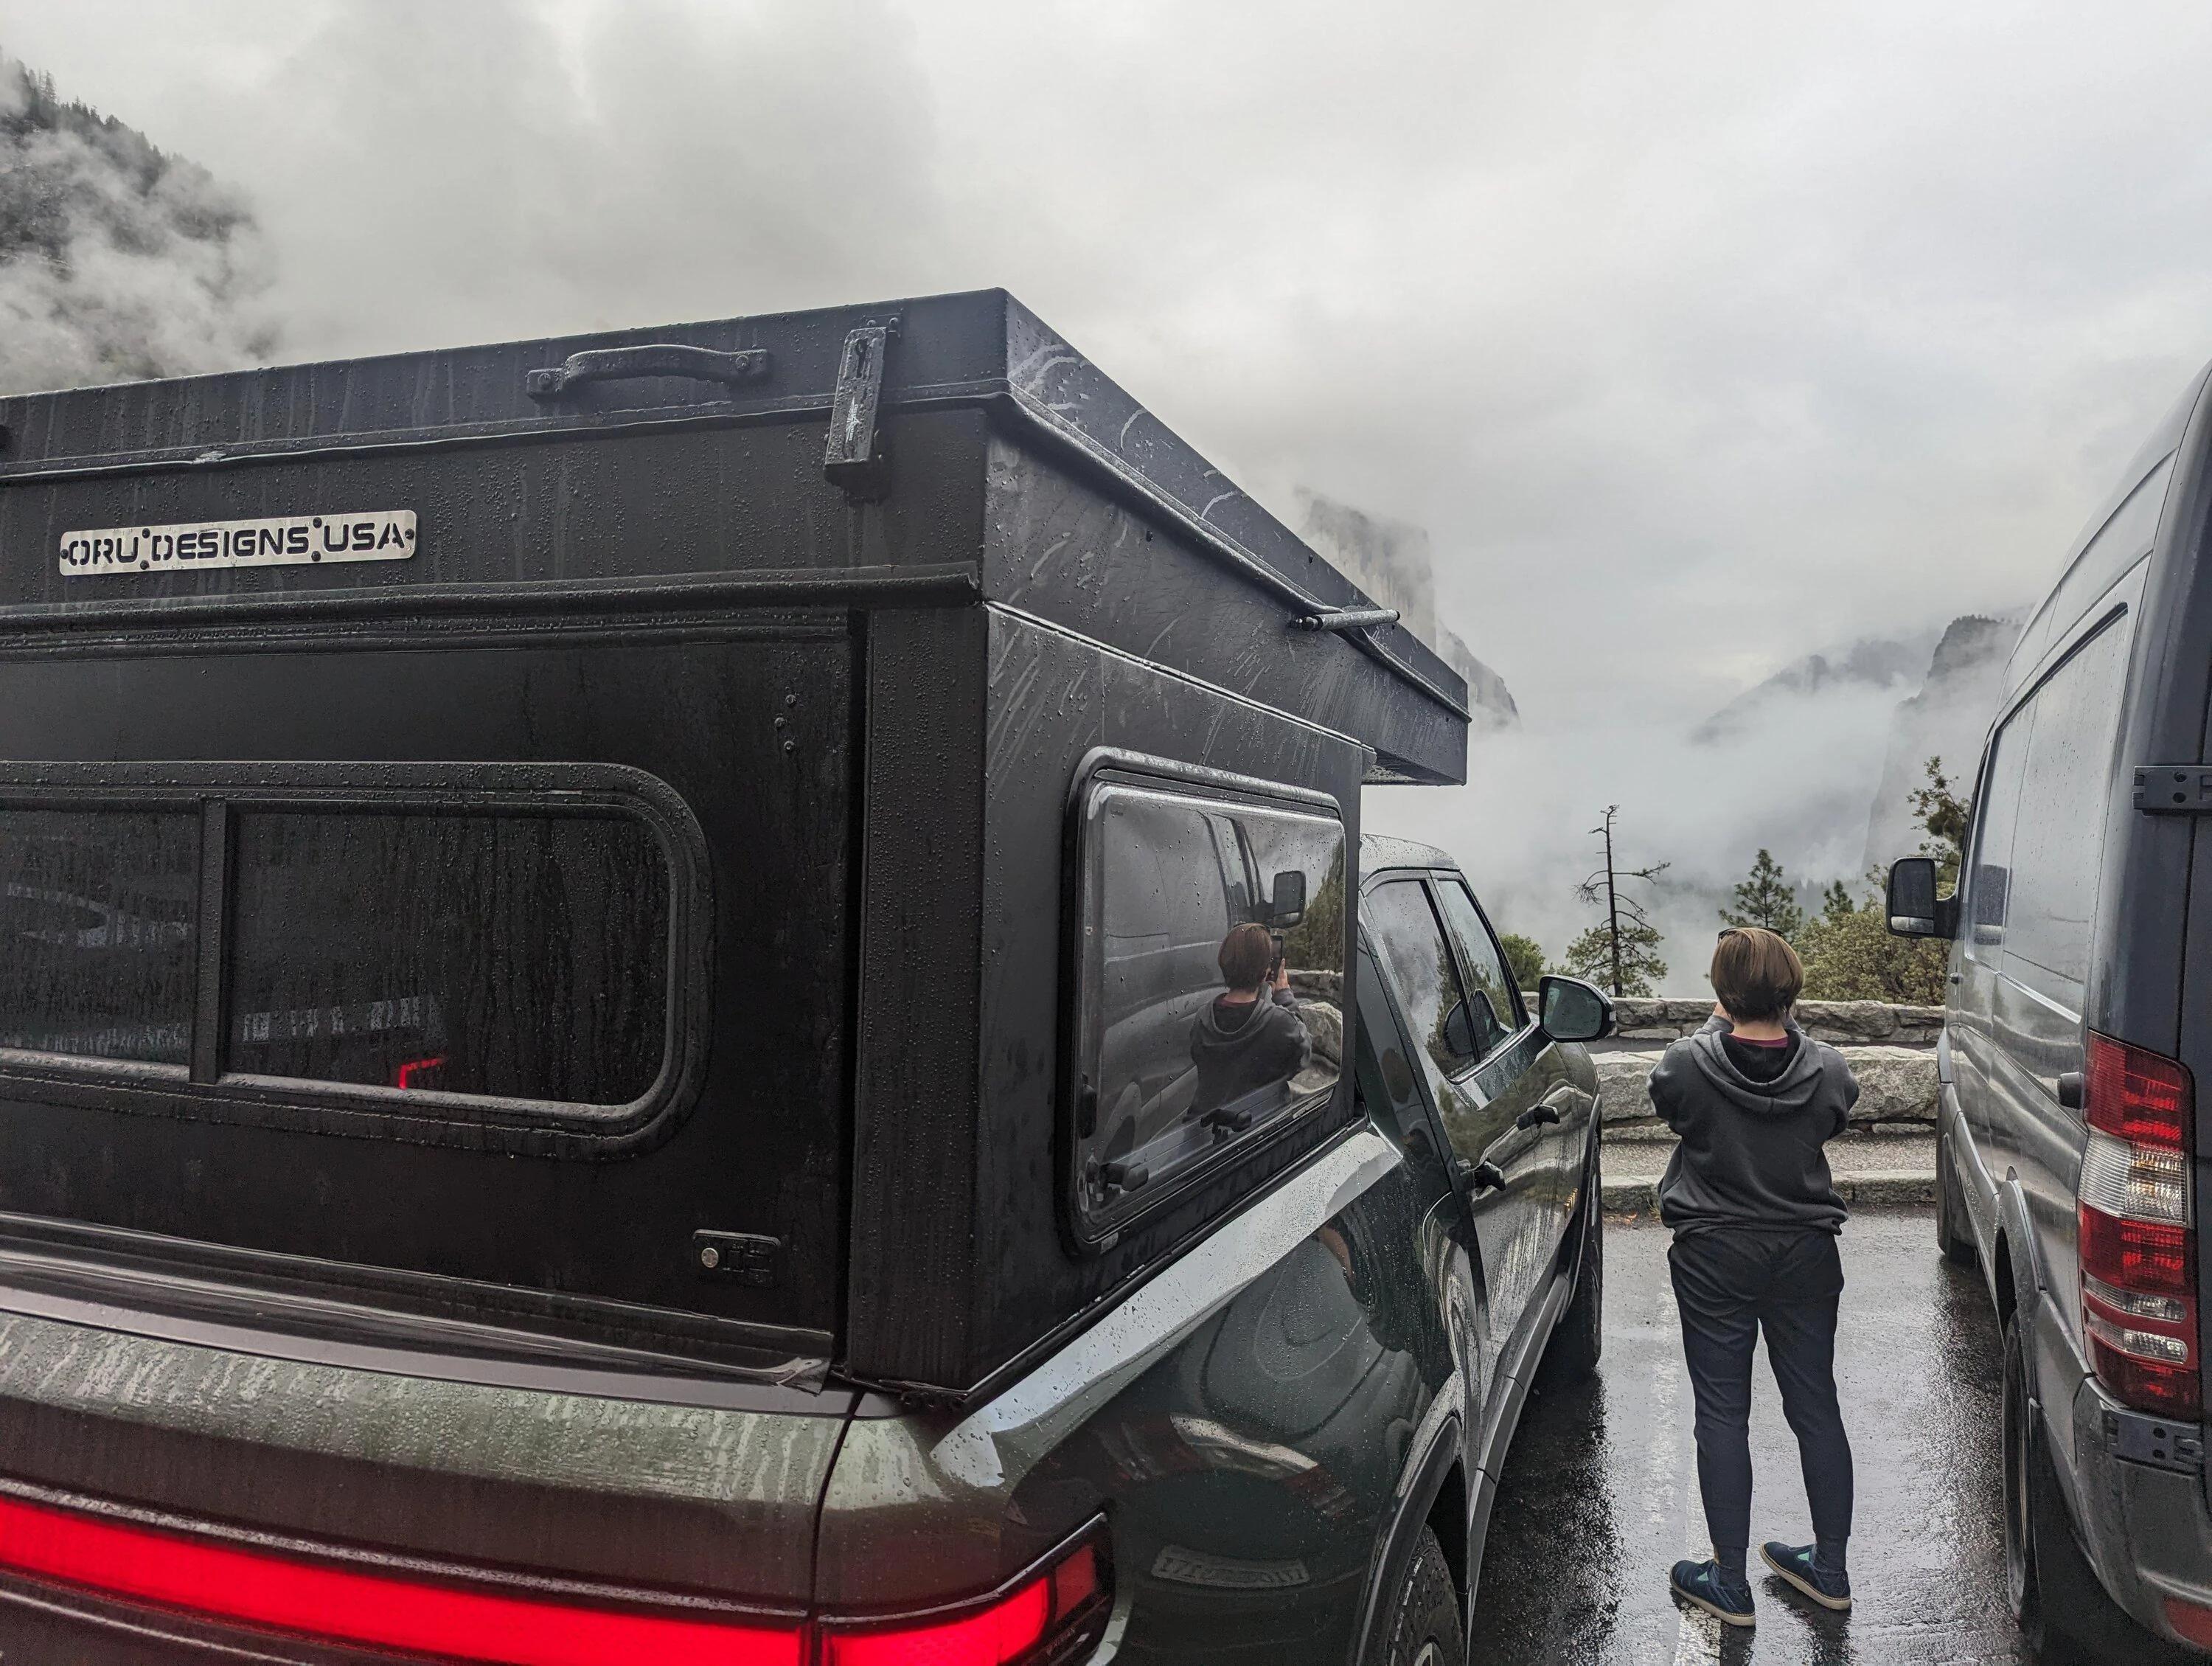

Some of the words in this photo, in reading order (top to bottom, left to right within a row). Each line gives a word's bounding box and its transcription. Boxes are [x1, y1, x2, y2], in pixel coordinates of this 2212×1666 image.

[69, 536, 139, 566] ORU
[151, 527, 309, 561] DESIGNS
[324, 522, 405, 552] USA
